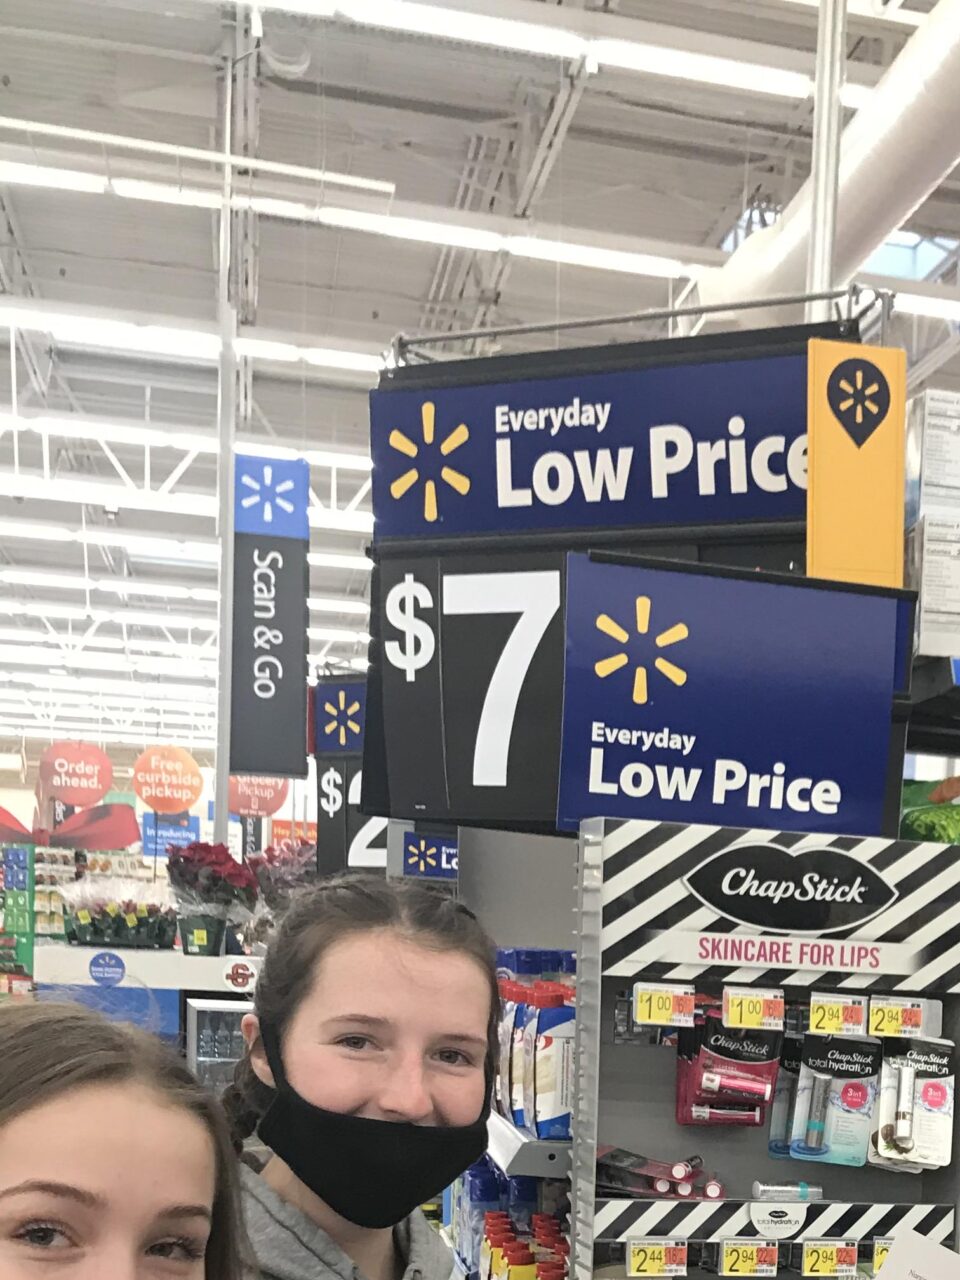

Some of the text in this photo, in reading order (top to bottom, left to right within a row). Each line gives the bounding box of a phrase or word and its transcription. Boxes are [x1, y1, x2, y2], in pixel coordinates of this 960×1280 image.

[494, 398, 610, 435] Everyday
[496, 438, 633, 508] Low
[252, 549, 283, 699] Scan & Go
[591, 722, 696, 756] Everyday
[54, 758, 100, 776] Order
[151, 756, 183, 772] Free
[52, 772, 102, 790] ahead.
[137, 771, 200, 787] curbside
[588, 747, 842, 815] Low Price
[141, 785, 196, 802] pickup.
[238, 782, 275, 799] Pickup
[146, 826, 196, 841] Inroducing
[721, 867, 864, 904] ChapStick
[698, 937, 880, 968] SKINCARE FOR LIPS
[710, 1035, 769, 1055] ChapStick
[808, 1057, 827, 1068] total
[828, 1050, 873, 1064] ChapStick
[907, 1050, 949, 1064] ChapStick
